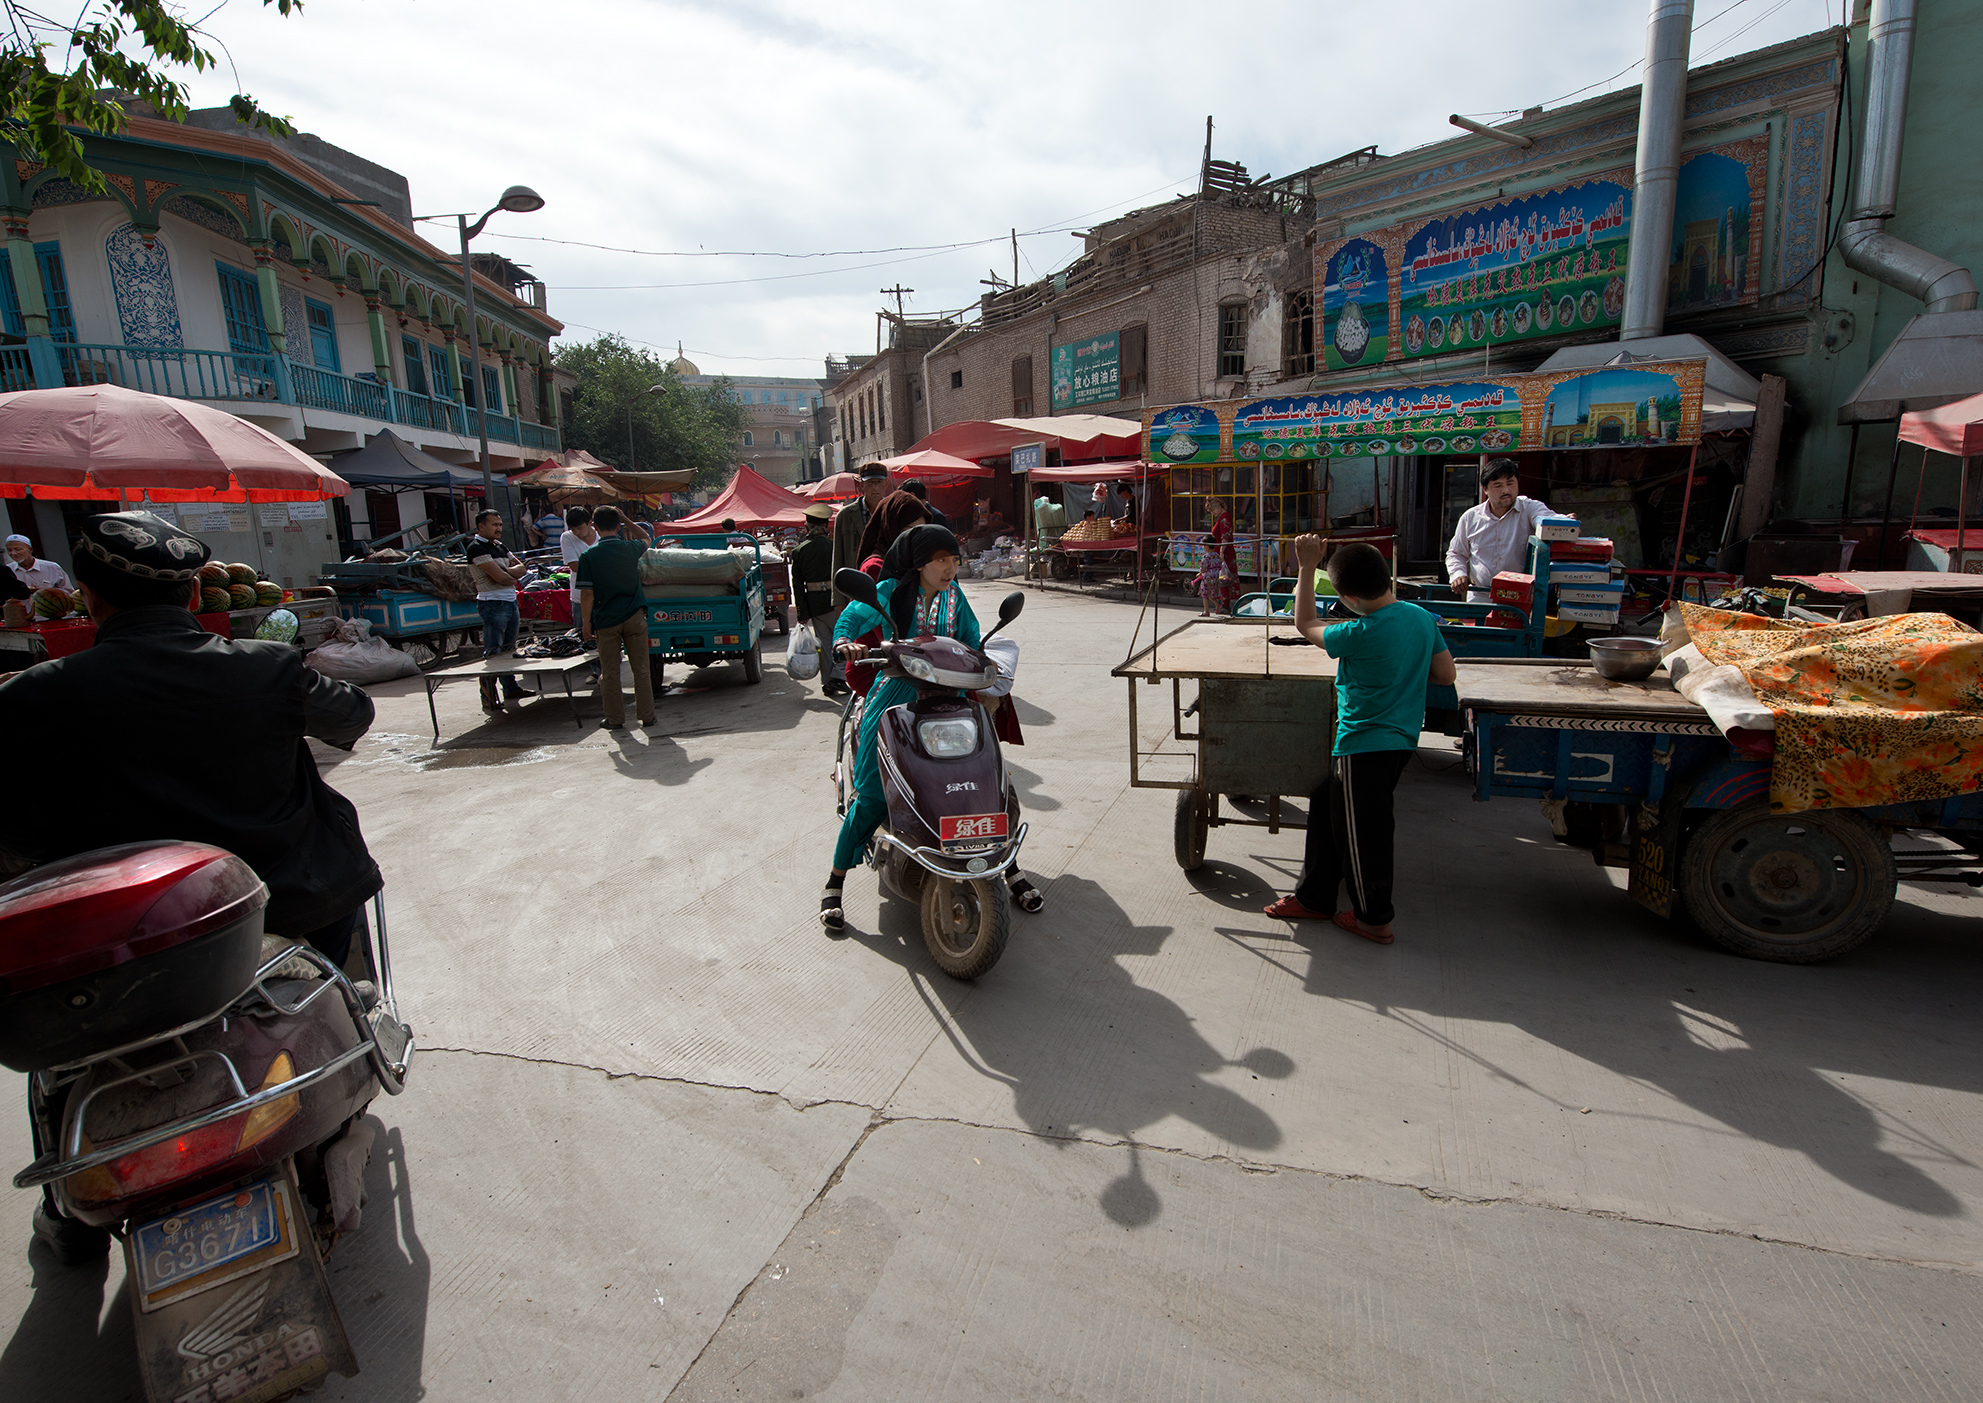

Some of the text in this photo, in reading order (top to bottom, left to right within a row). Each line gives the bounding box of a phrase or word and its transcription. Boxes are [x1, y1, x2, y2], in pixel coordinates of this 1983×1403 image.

[1074, 367, 1118, 390] 放心粮油店
[946, 781, 979, 794] 绿佳
[954, 817, 996, 838] 绿佳
[1638, 837, 1664, 873] 520
[154, 1216, 258, 1278] G3671
[187, 1322, 297, 1383] HONDA
